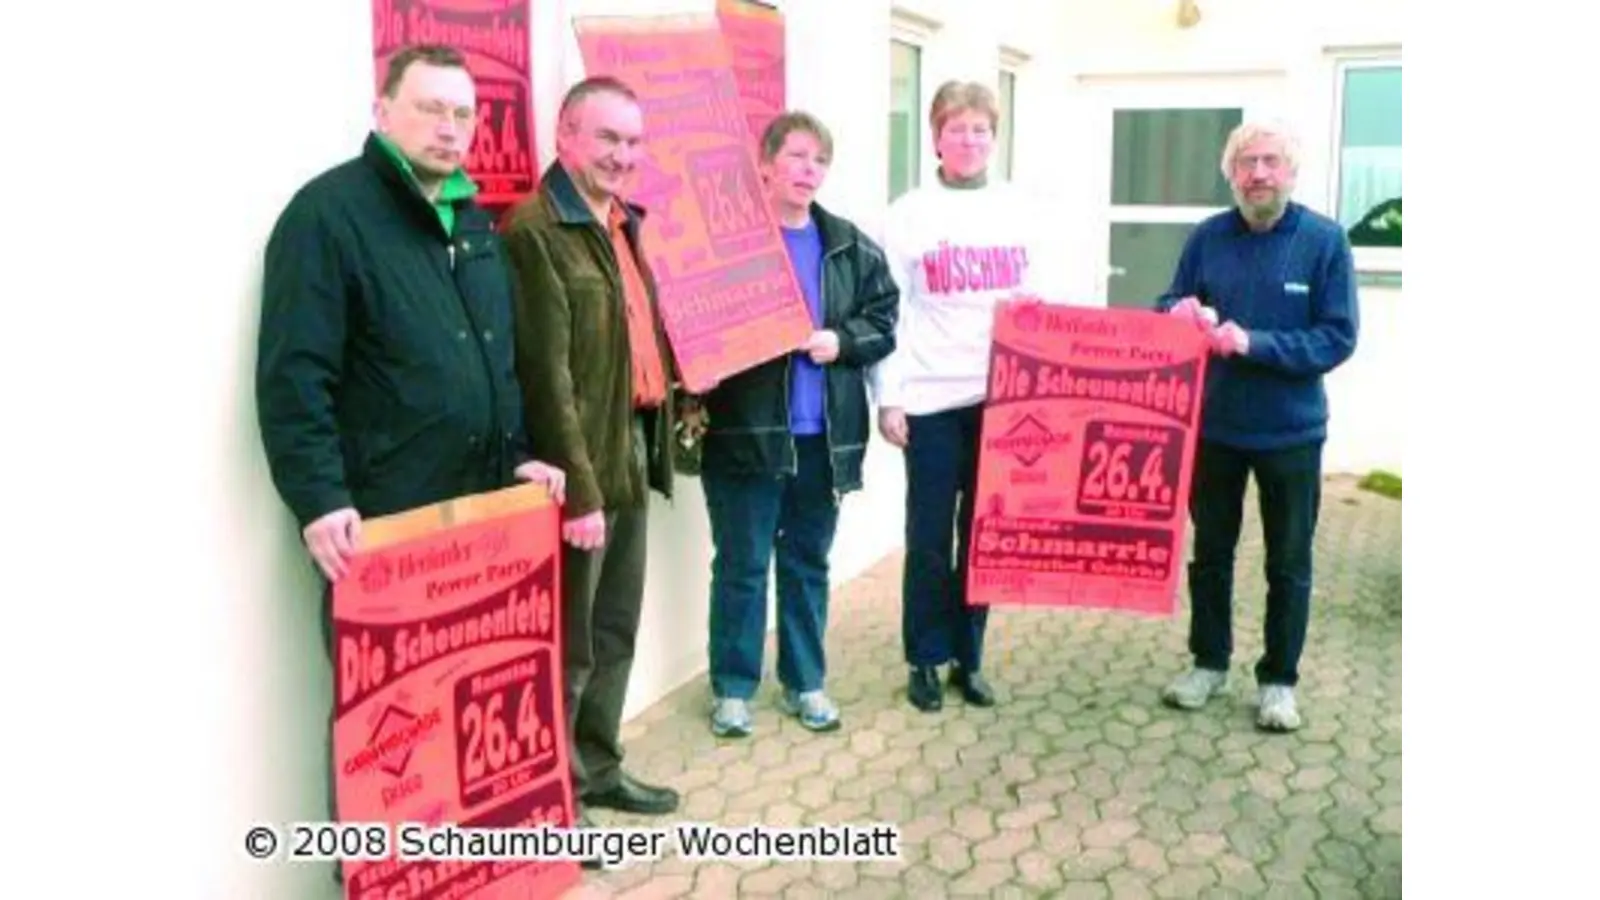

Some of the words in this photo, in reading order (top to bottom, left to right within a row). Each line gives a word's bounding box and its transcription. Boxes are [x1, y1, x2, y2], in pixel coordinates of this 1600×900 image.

[991, 353, 1031, 401] Die
[1036, 366, 1191, 418] Scheunenfete
[1081, 441, 1172, 504] 26.4.
[486, 555, 534, 583] Party
[977, 531, 1168, 563] Schmarrie
[341, 630, 386, 704] Die
[393, 584, 551, 673] Scheunenfete
[462, 680, 552, 782] 26.4.
